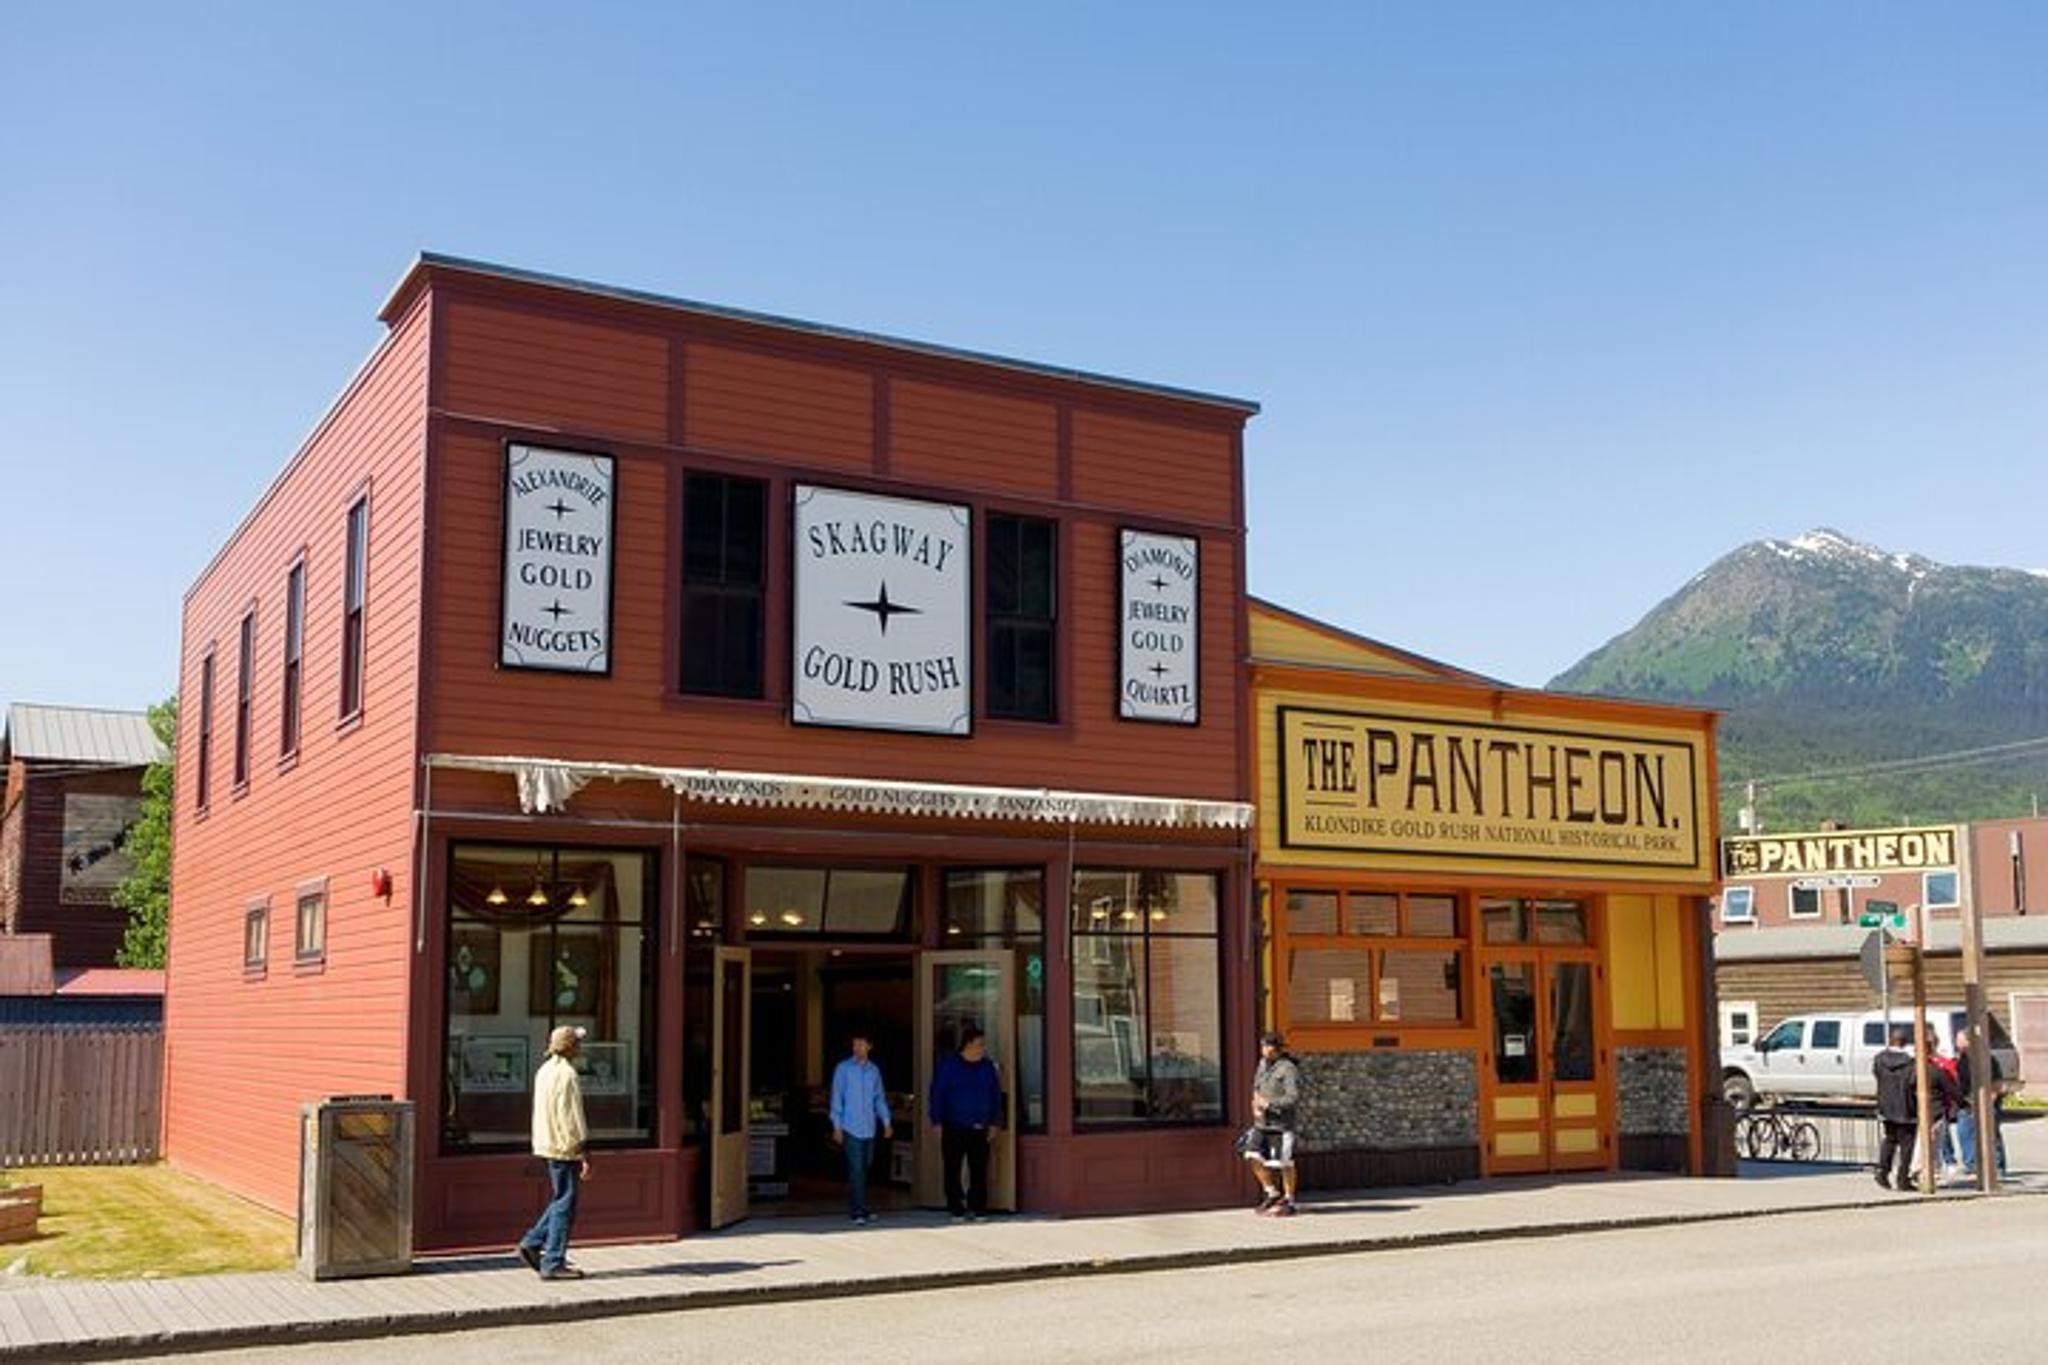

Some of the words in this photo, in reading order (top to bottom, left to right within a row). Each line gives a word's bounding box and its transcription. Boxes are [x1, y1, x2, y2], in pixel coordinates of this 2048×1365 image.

[518, 528, 603, 558] JEWELRY
[809, 520, 954, 573] SKAGWAY
[520, 562, 592, 590] GOLD
[1125, 547, 1193, 581] DIAMOND
[1128, 601, 1190, 625] JEWELRY
[508, 621, 602, 652] NUGGETS
[1131, 629, 1184, 653] GOLD
[803, 645, 880, 694] GOLD
[888, 656, 961, 696] RUSH
[1125, 678, 1190, 706] QUARTZ
[1302, 737, 1356, 793] THE
[829, 784, 879, 803] GOLD
[883, 788, 957, 808] NUGGETS
[1304, 815, 1387, 836] KLONDIKE
[1391, 820, 1437, 840] GOLD
[1439, 822, 1481, 842] RUSH
[1484, 825, 1555, 846] NATIONAL
[1558, 828, 1641, 851] HISTORICAL
[1760, 832, 1950, 871] PANTHEON
